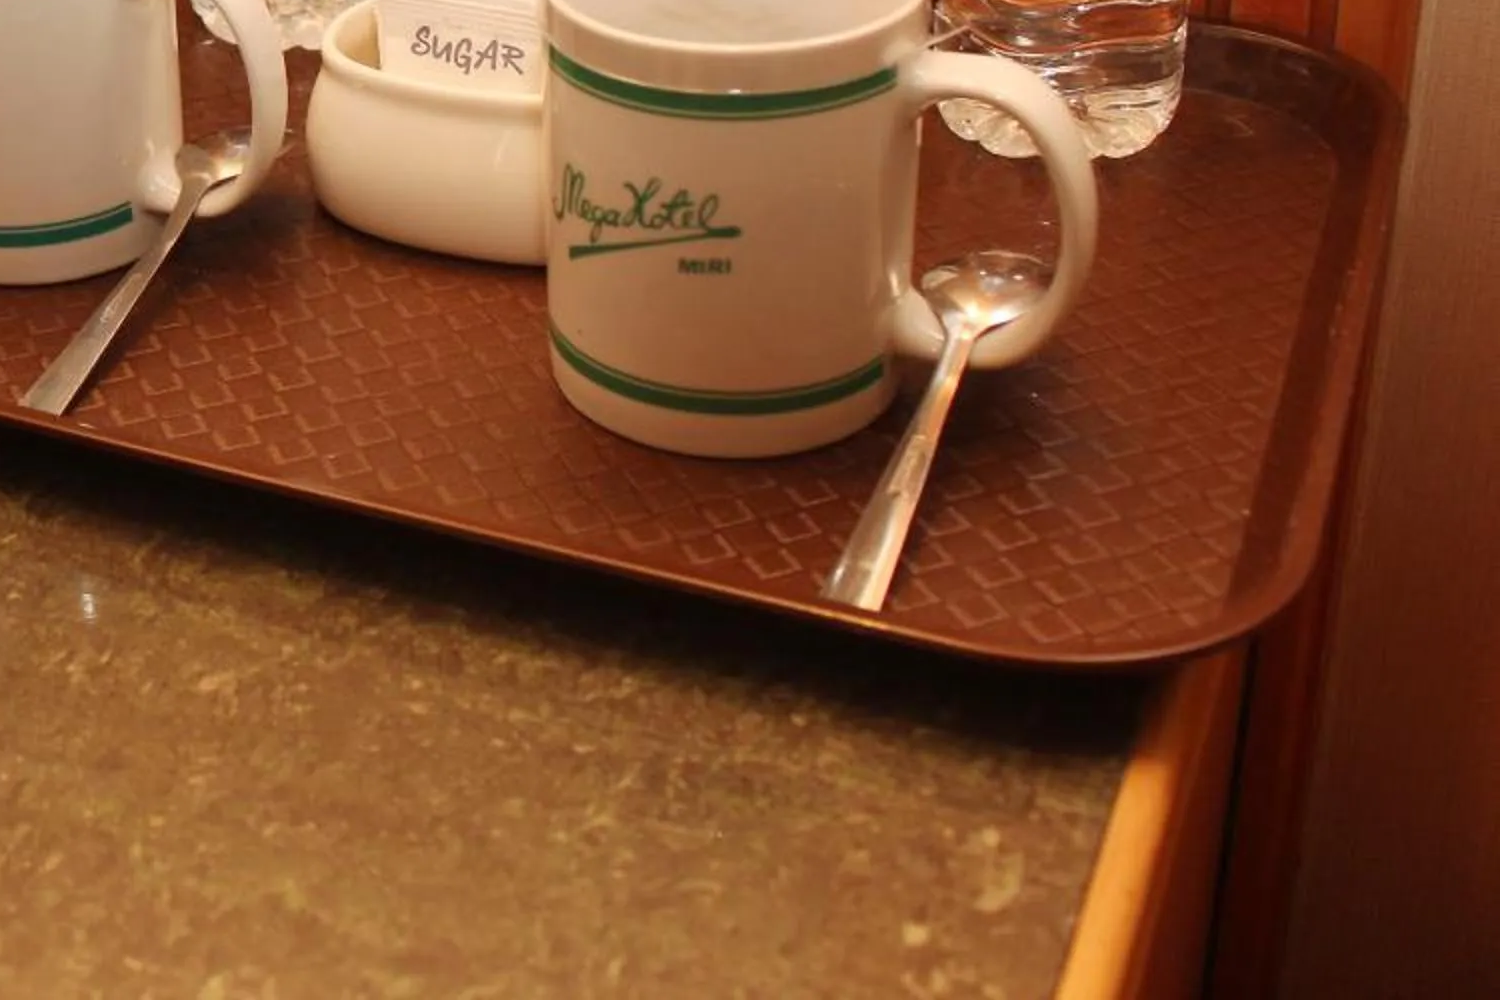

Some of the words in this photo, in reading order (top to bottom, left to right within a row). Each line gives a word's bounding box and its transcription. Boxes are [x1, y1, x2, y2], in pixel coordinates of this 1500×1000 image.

[411, 24, 526, 76] SUGAR
[553, 161, 624, 242] Mega
[623, 176, 721, 233] Hotel
[677, 257, 732, 275] MIRI
